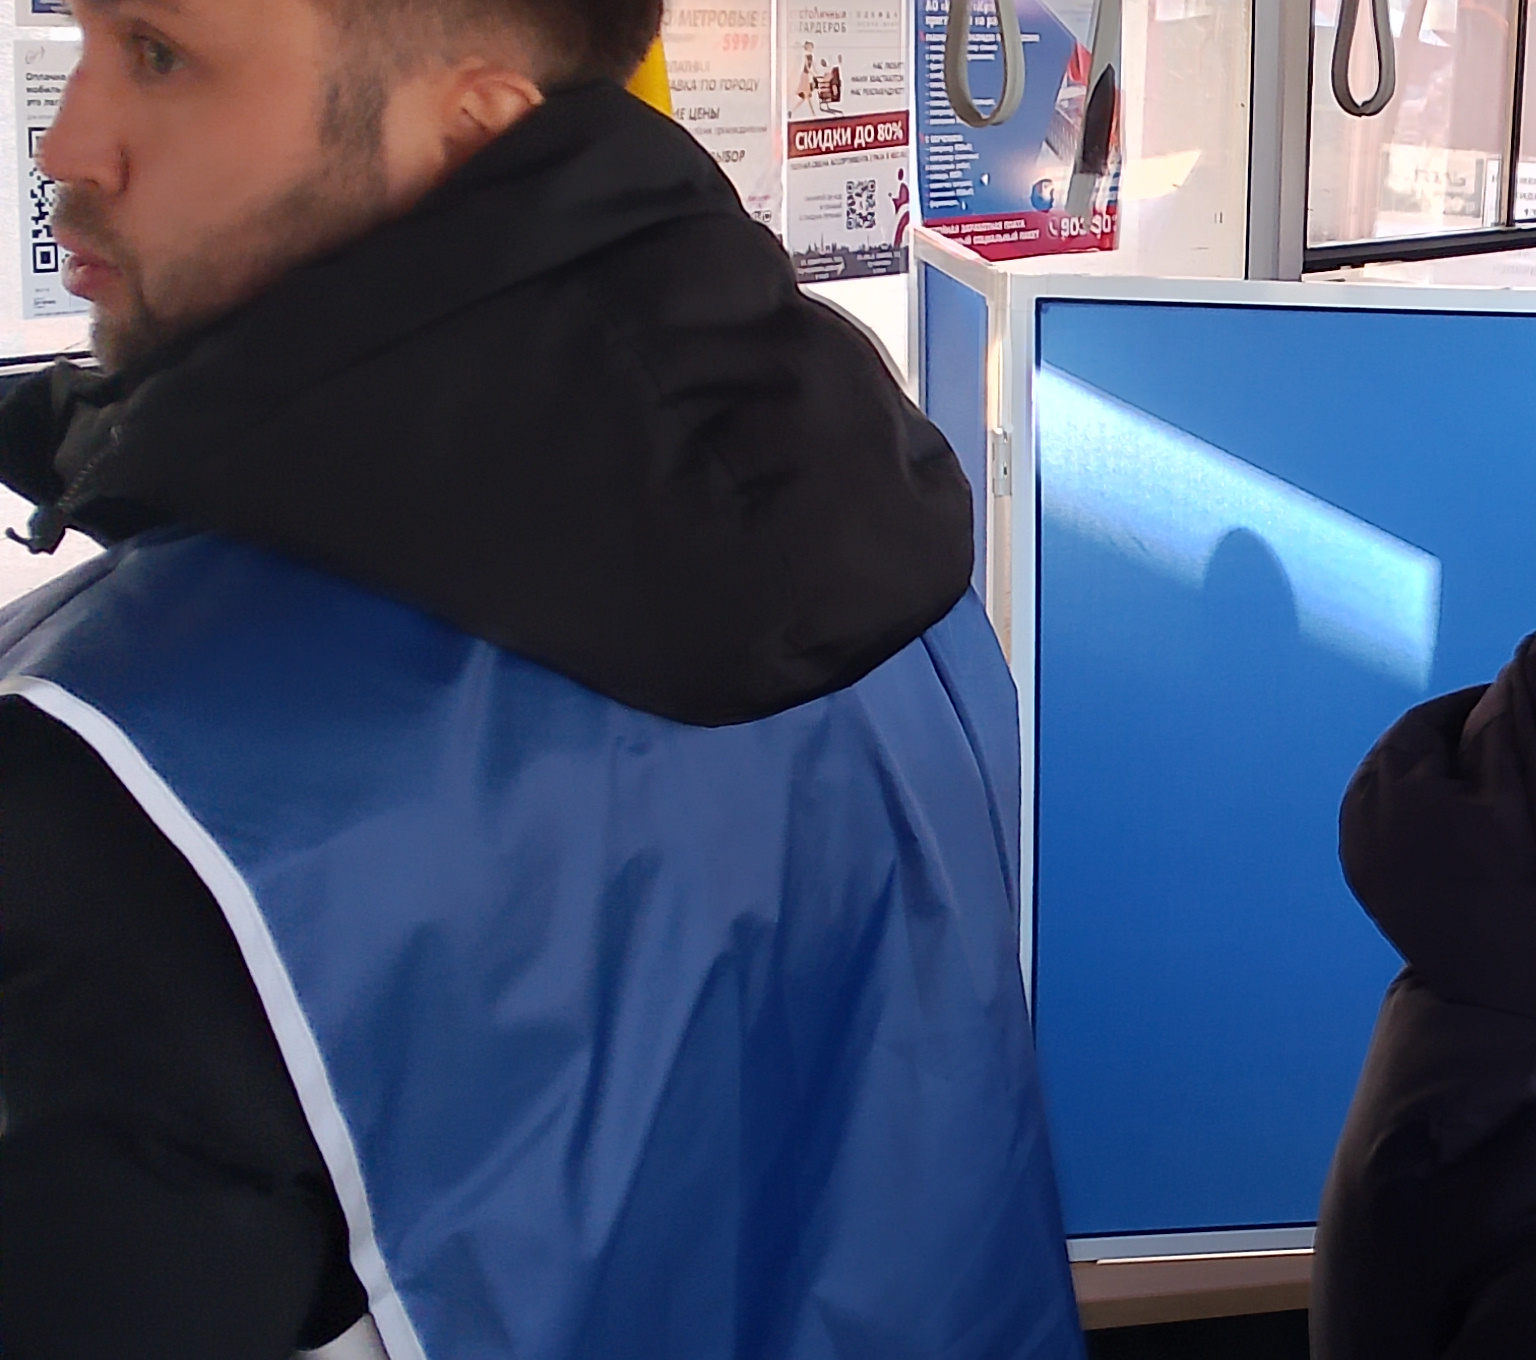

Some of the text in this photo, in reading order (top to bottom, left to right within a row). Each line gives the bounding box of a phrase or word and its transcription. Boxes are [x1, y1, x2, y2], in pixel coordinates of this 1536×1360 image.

[689, 107, 720, 120] ЦЕНЫ
[796, 120, 903, 151] СКИДКИ ДО 80%
